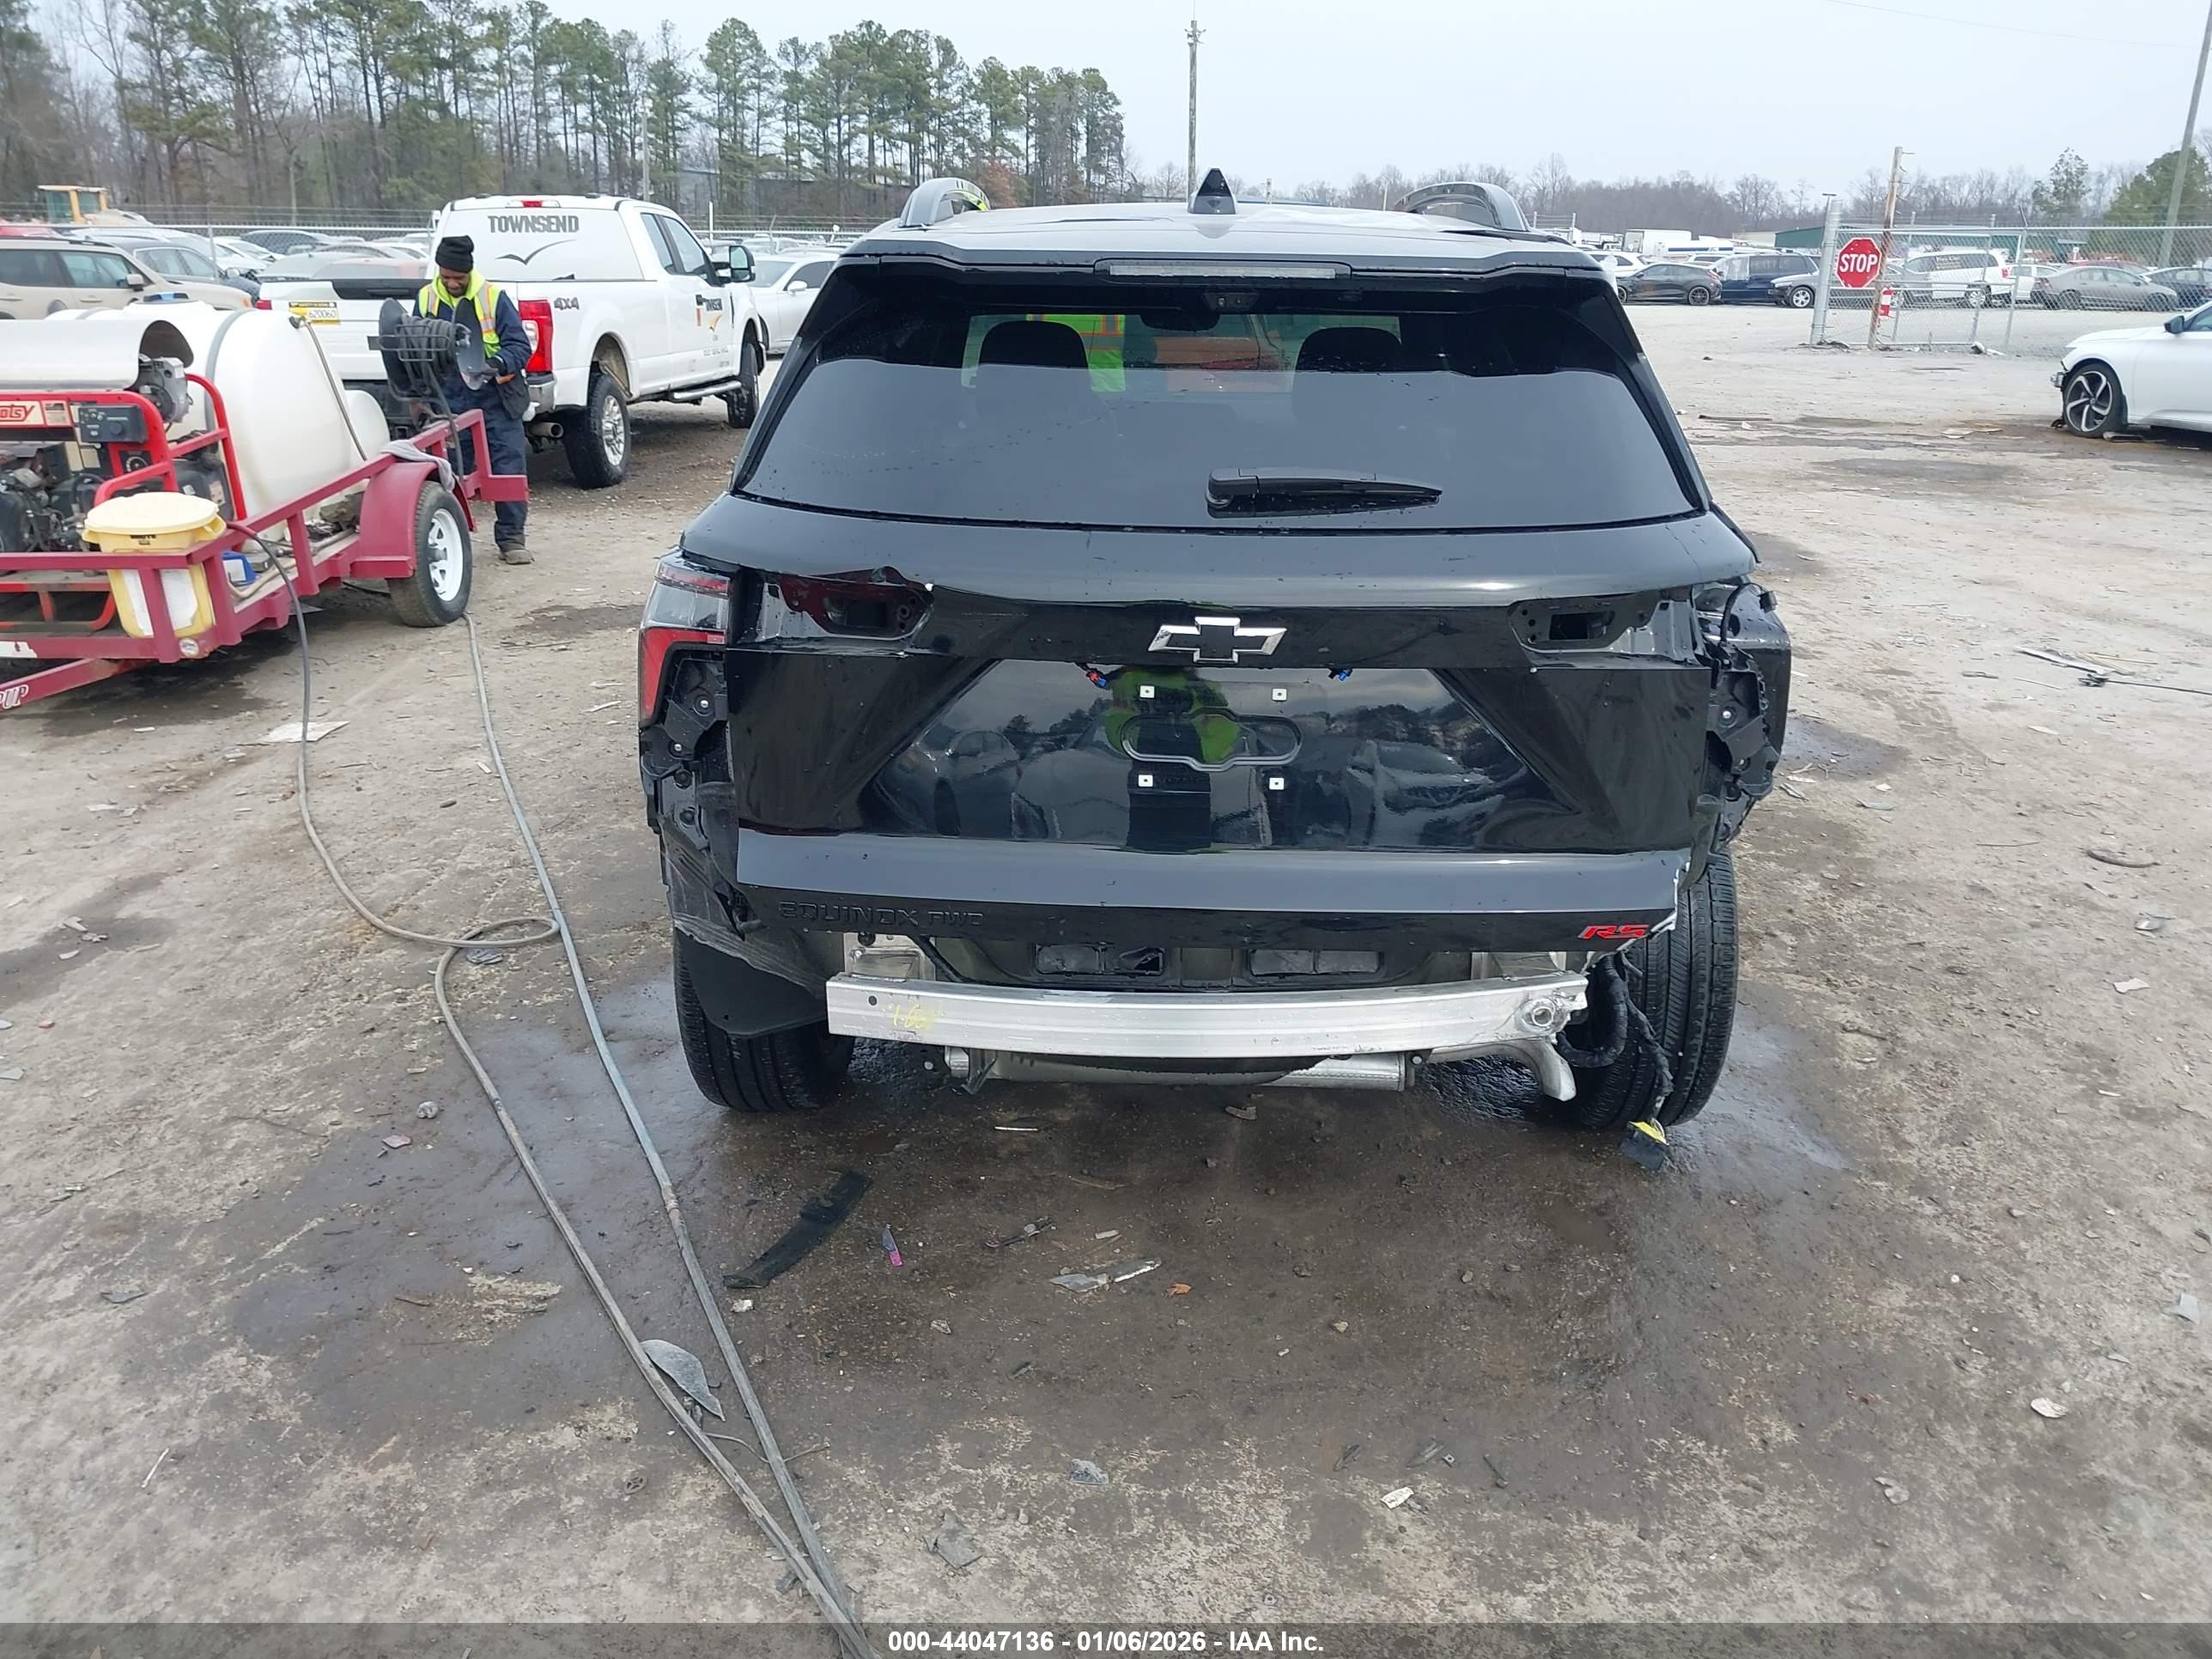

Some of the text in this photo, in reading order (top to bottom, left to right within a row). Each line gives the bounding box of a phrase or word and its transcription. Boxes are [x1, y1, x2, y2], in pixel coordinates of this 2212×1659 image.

[488, 215, 580, 234] TOWNSEND
[1839, 253, 1877, 273] STOP
[779, 902, 919, 925] EQUINOX
[1577, 924, 1649, 939] RS
